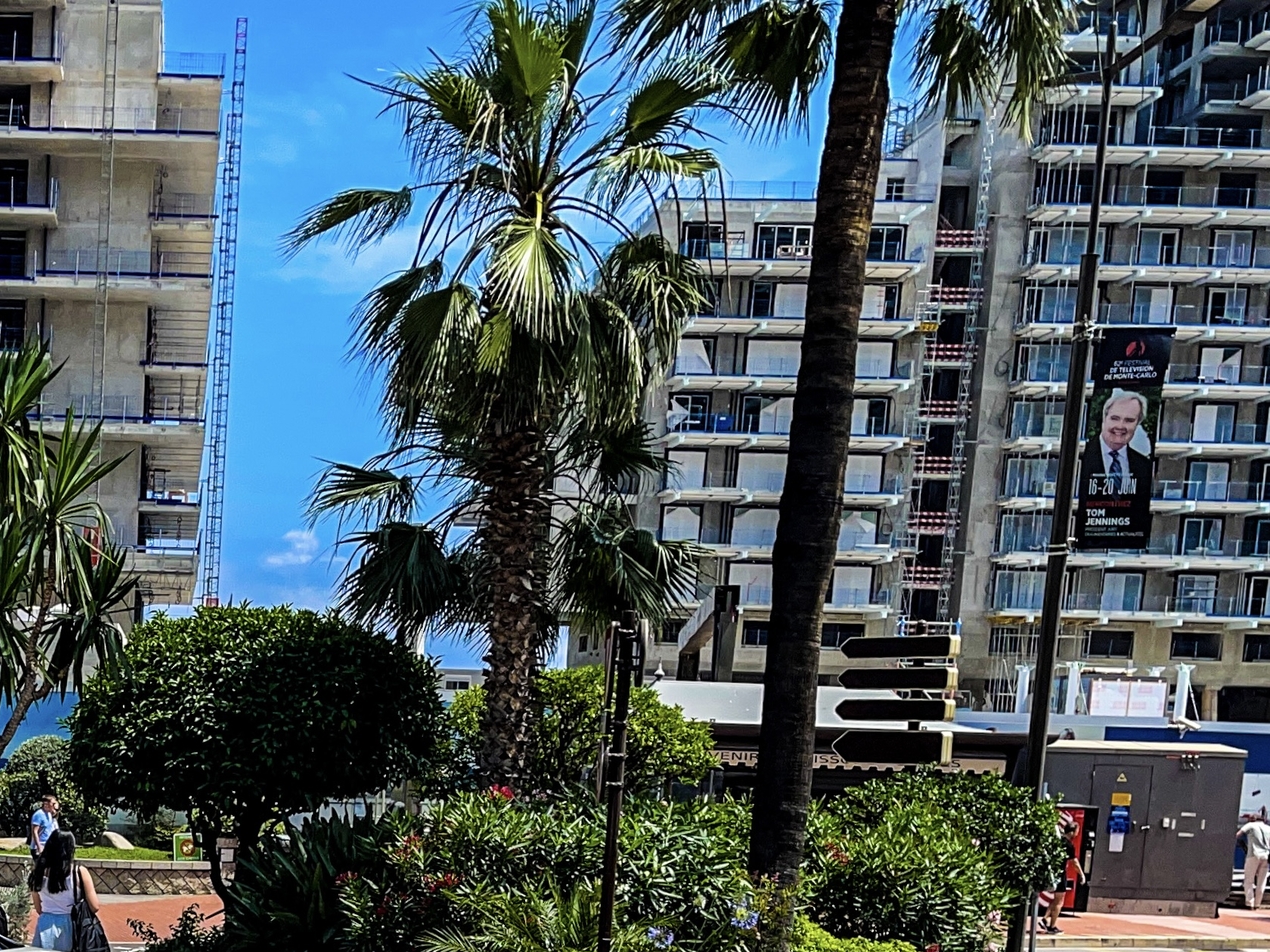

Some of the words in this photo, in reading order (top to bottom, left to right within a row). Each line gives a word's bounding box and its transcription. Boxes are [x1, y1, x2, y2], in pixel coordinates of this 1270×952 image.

[1113, 371, 1157, 379] MONTE-CARLO
[1088, 478, 1115, 495] 16-20
[1117, 478, 1137, 495] JUIN
[1085, 508, 1106, 517] TOM
[1085, 517, 1131, 526] JENNINGS
